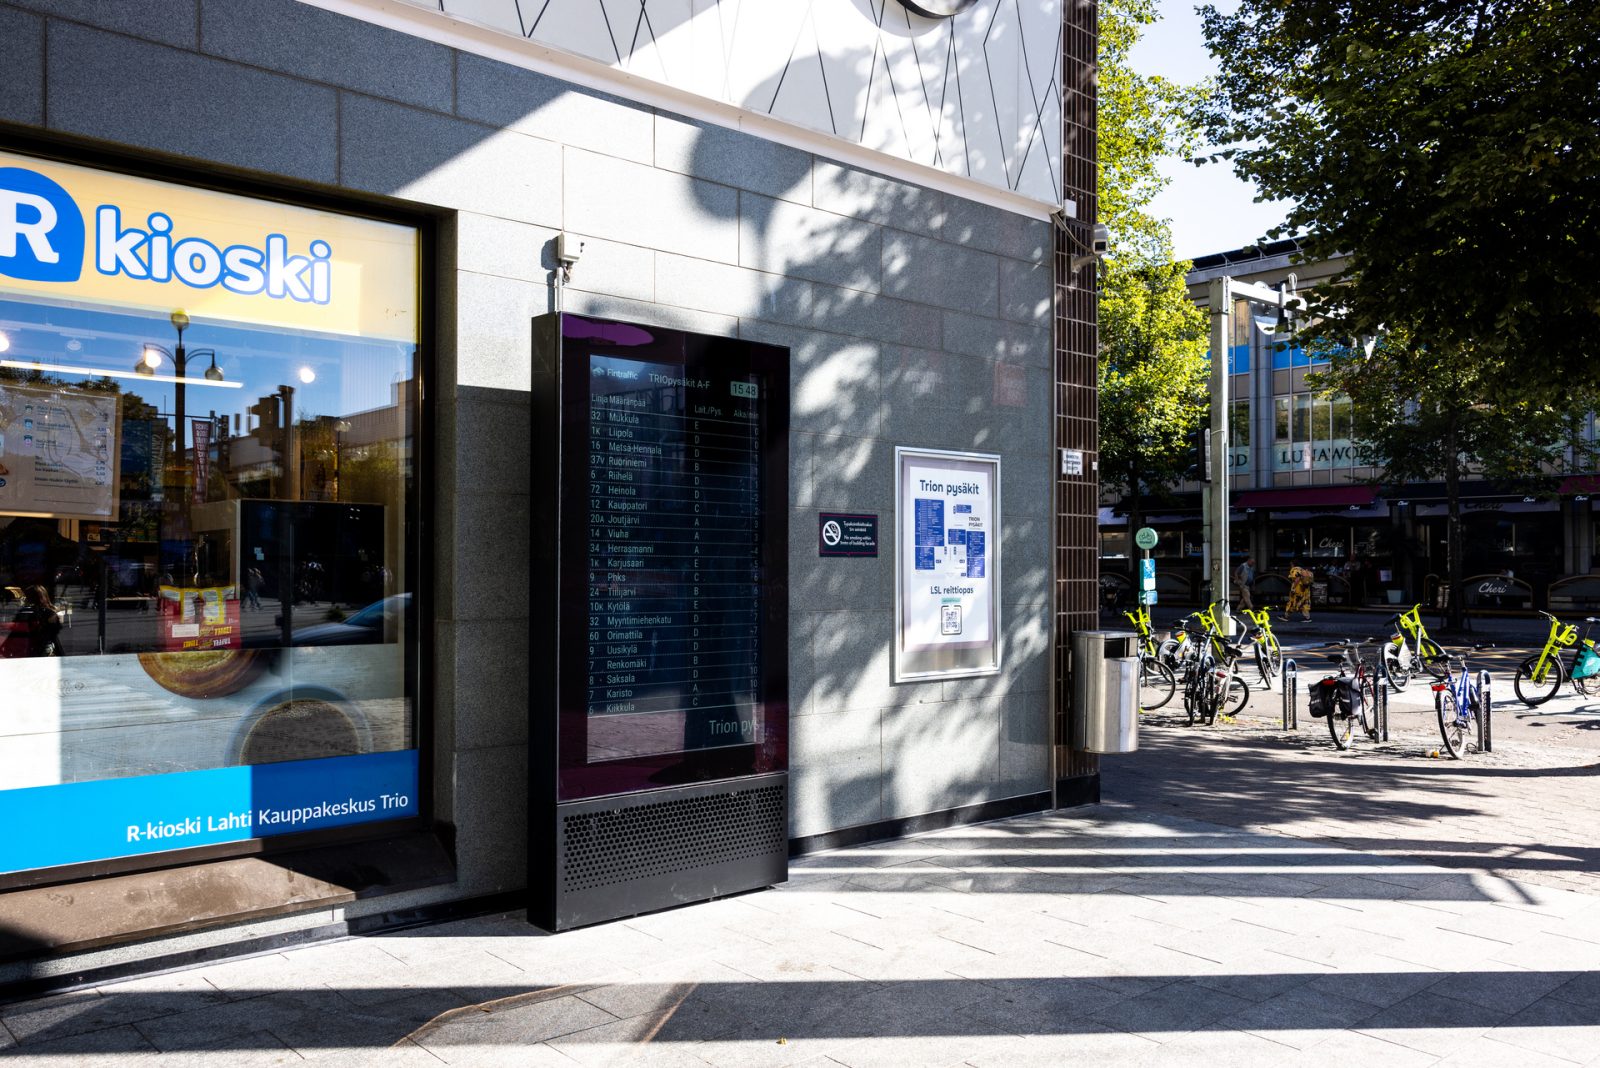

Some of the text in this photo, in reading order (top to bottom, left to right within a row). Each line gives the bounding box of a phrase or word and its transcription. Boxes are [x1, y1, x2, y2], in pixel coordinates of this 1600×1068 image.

[0, 188, 332, 305] R kioski
[607, 369, 639, 379] Fintraffic
[697, 380, 711, 389] A-F
[592, 411, 600, 420] 32
[609, 413, 639, 424] Mukkula
[694, 421, 699, 430] E
[609, 427, 633, 438] Liipola
[592, 441, 600, 449] 16
[609, 443, 661, 454] Metsä-Hennala
[609, 457, 647, 467] Ruoriniemi
[609, 471, 633, 481] Riihelä
[590, 485, 600, 494] 72
[608, 486, 636, 495] Heinola
[920, 479, 979, 496] Trion pysäkit
[591, 500, 600, 509] 12
[608, 500, 647, 511] Kauppatori
[608, 515, 639, 526] Joutjärvi
[694, 517, 700, 527] A
[591, 528, 599, 538] 14
[608, 529, 629, 538] Viuha
[694, 531, 700, 540] A
[590, 544, 599, 552] 34
[608, 544, 654, 553] Herrasmanni
[694, 545, 700, 554] A
[608, 558, 644, 569] Karjusaari
[694, 559, 699, 568] E
[590, 573, 594, 582] 9
[694, 572, 700, 582] C
[590, 588, 599, 597] 24
[930, 585, 974, 596] LSL reittiopas
[1478, 582, 1507, 594] Cheri
[608, 602, 630, 613] Kytölä
[694, 600, 698, 610] E
[589, 617, 599, 626] 32
[608, 616, 672, 628] Myyntimiehenkatu
[589, 632, 599, 640] 60
[607, 631, 643, 640] Orimattila
[590, 646, 594, 655] 9
[607, 646, 638, 655] Uusikylä
[590, 661, 594, 670] 7
[607, 659, 647, 669] Renkomäki
[589, 676, 594, 685] 8
[607, 674, 635, 684] Saksala
[589, 691, 594, 700] 7
[607, 689, 633, 698] Karisto
[693, 683, 698, 693] A
[607, 702, 635, 713] Kiikkula
[692, 696, 698, 706] C
[708, 720, 738, 736] Trion
[126, 792, 409, 842] R-kioski Lahti Kauppakeskus Trio
